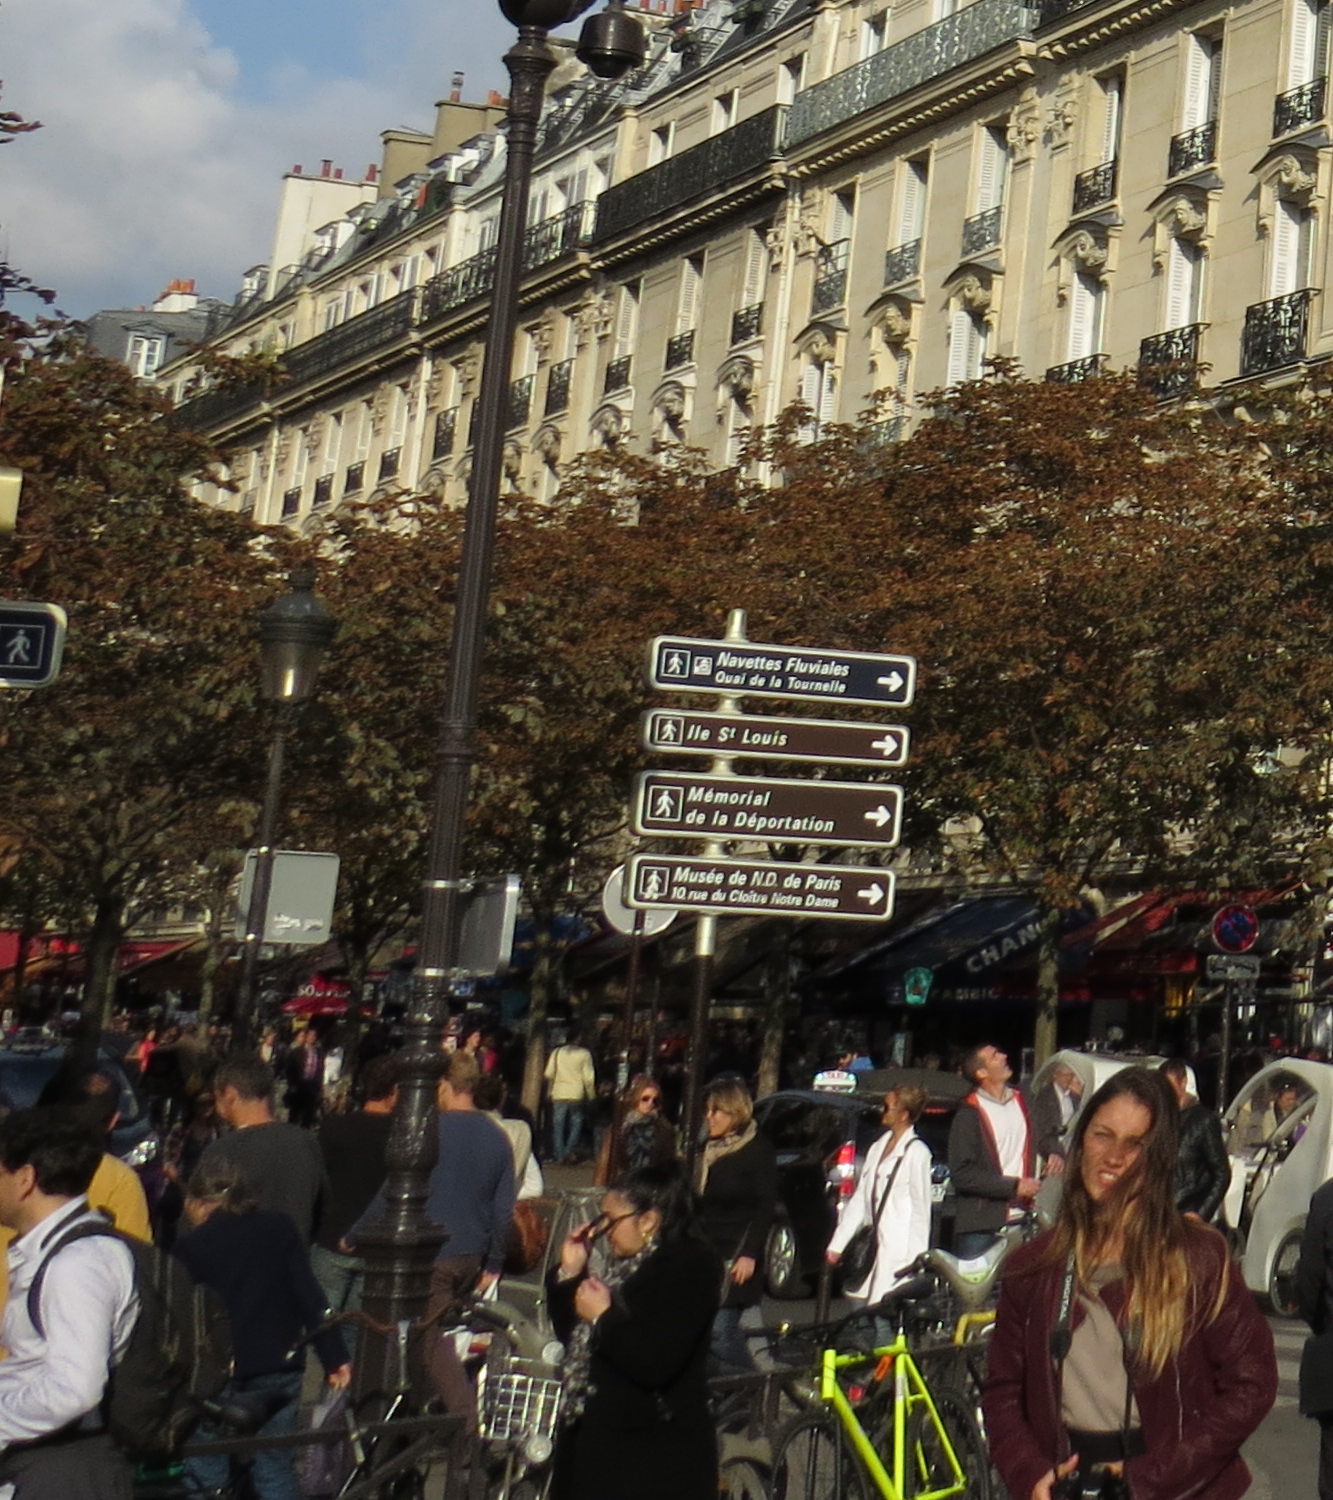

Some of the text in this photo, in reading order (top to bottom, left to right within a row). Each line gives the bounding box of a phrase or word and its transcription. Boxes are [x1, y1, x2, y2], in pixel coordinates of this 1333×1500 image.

[716, 652, 850, 676] Navettes Fluviales
[715, 670, 847, 693] Quai de la Tournelle
[687, 724, 788, 746] Ile St Louis
[688, 786, 771, 807] Mémorial
[685, 809, 835, 832] de la Déportation
[673, 866, 725, 884] Musée
[728, 870, 747, 886] de
[783, 873, 802, 889] de
[805, 874, 842, 891] Paris
[688, 890, 708, 901] rue
[711, 889, 726, 902] du
[729, 889, 768, 905] Cloître
[770, 892, 803, 906] Notre
[805, 893, 839, 908] Dame
